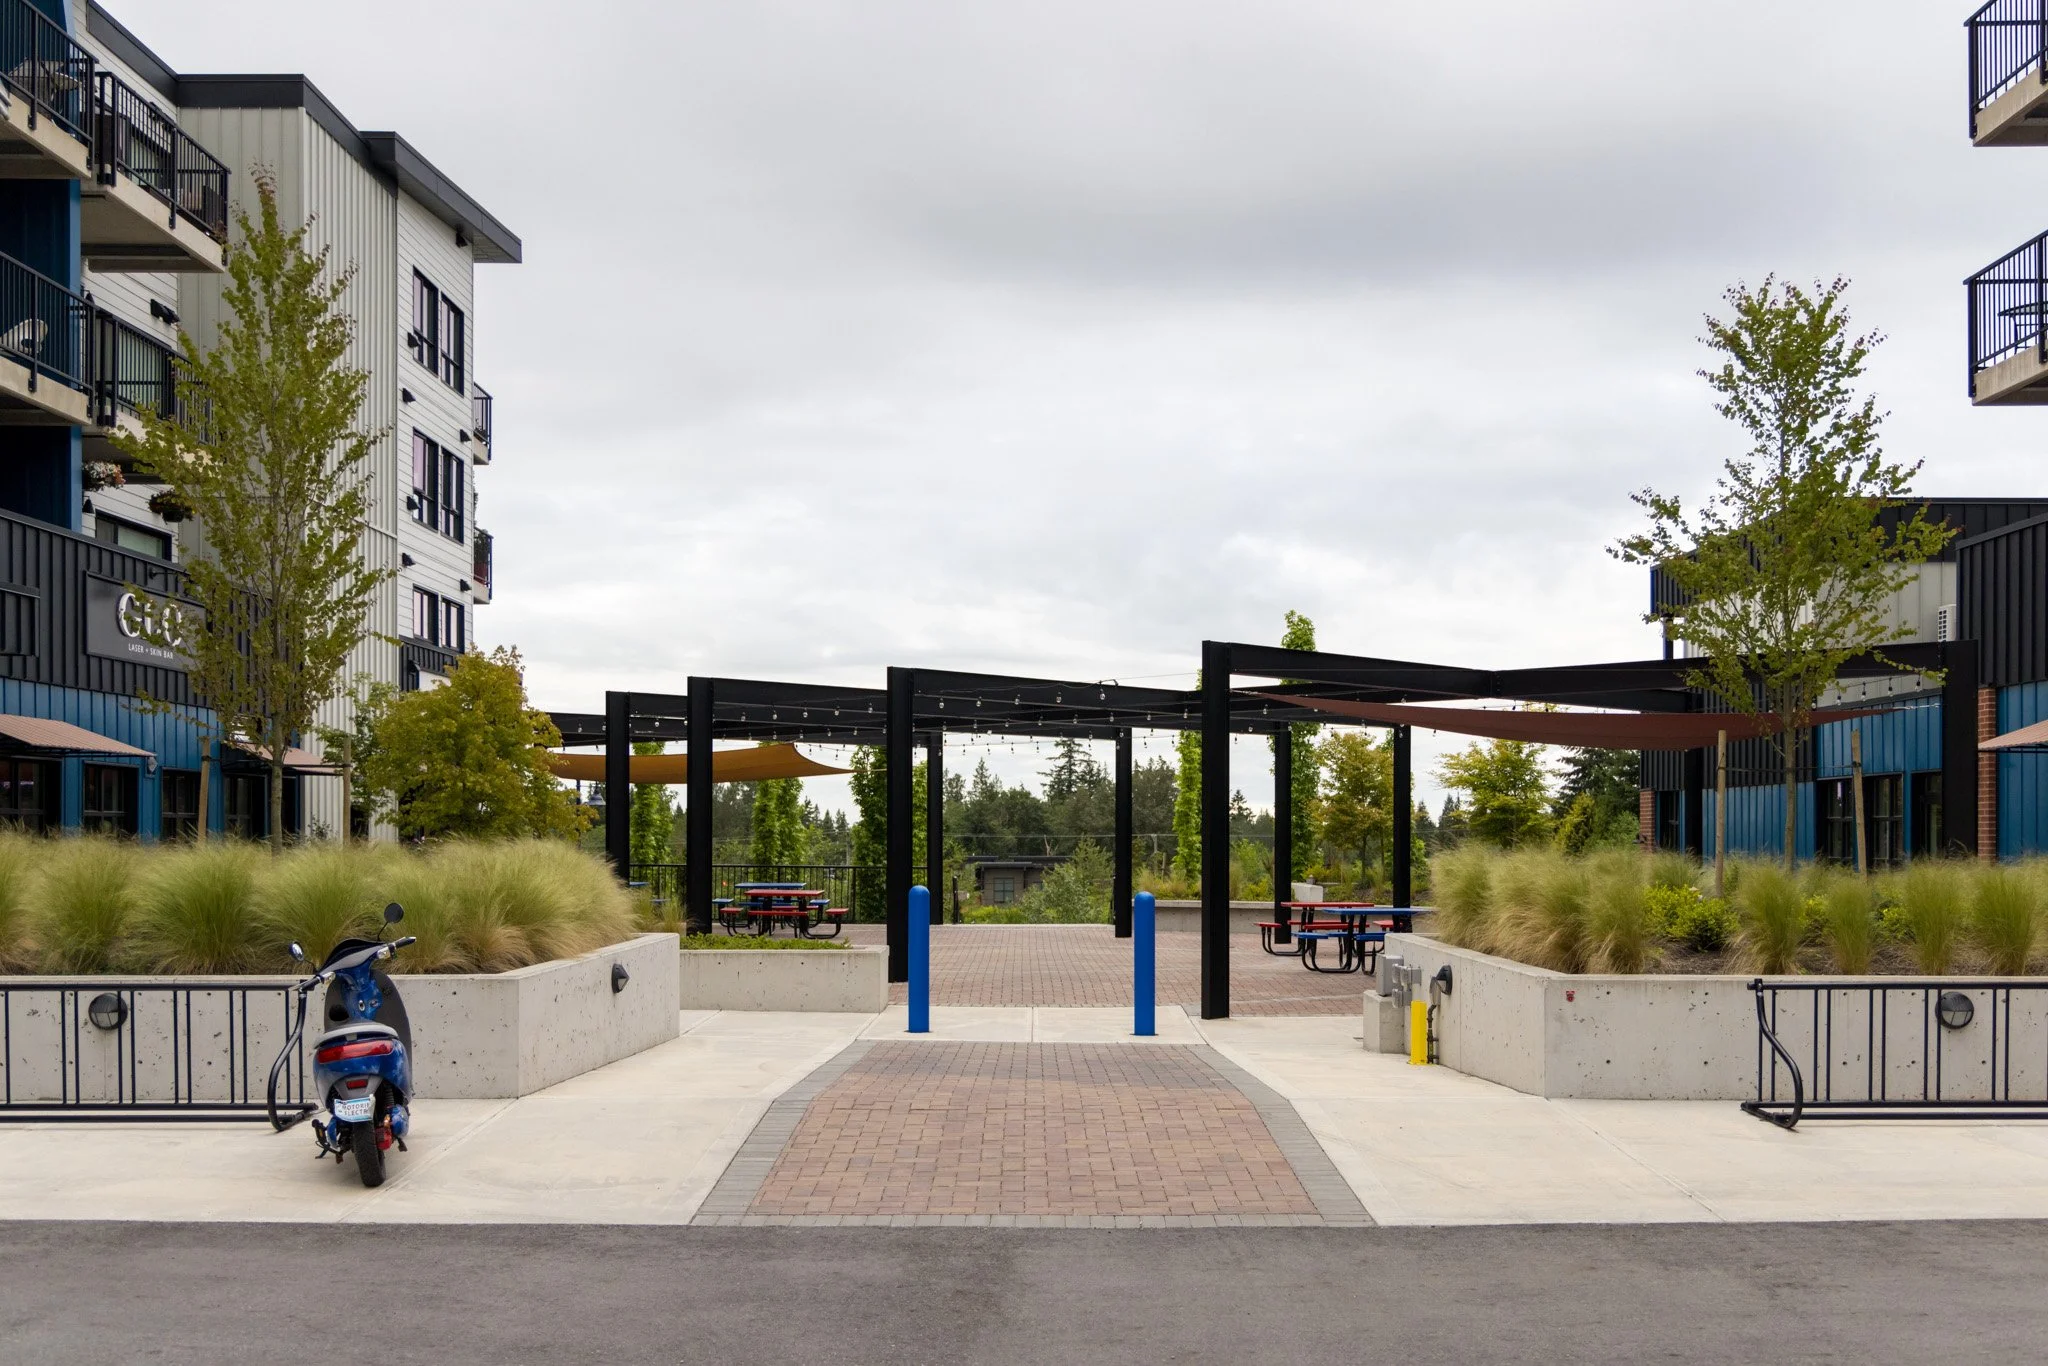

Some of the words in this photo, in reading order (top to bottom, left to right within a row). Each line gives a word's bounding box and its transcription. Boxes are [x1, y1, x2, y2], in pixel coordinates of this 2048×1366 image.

[128, 643, 144, 653] LASER
[150, 647, 162, 657] SKIN
[163, 650, 173, 660] BAR
